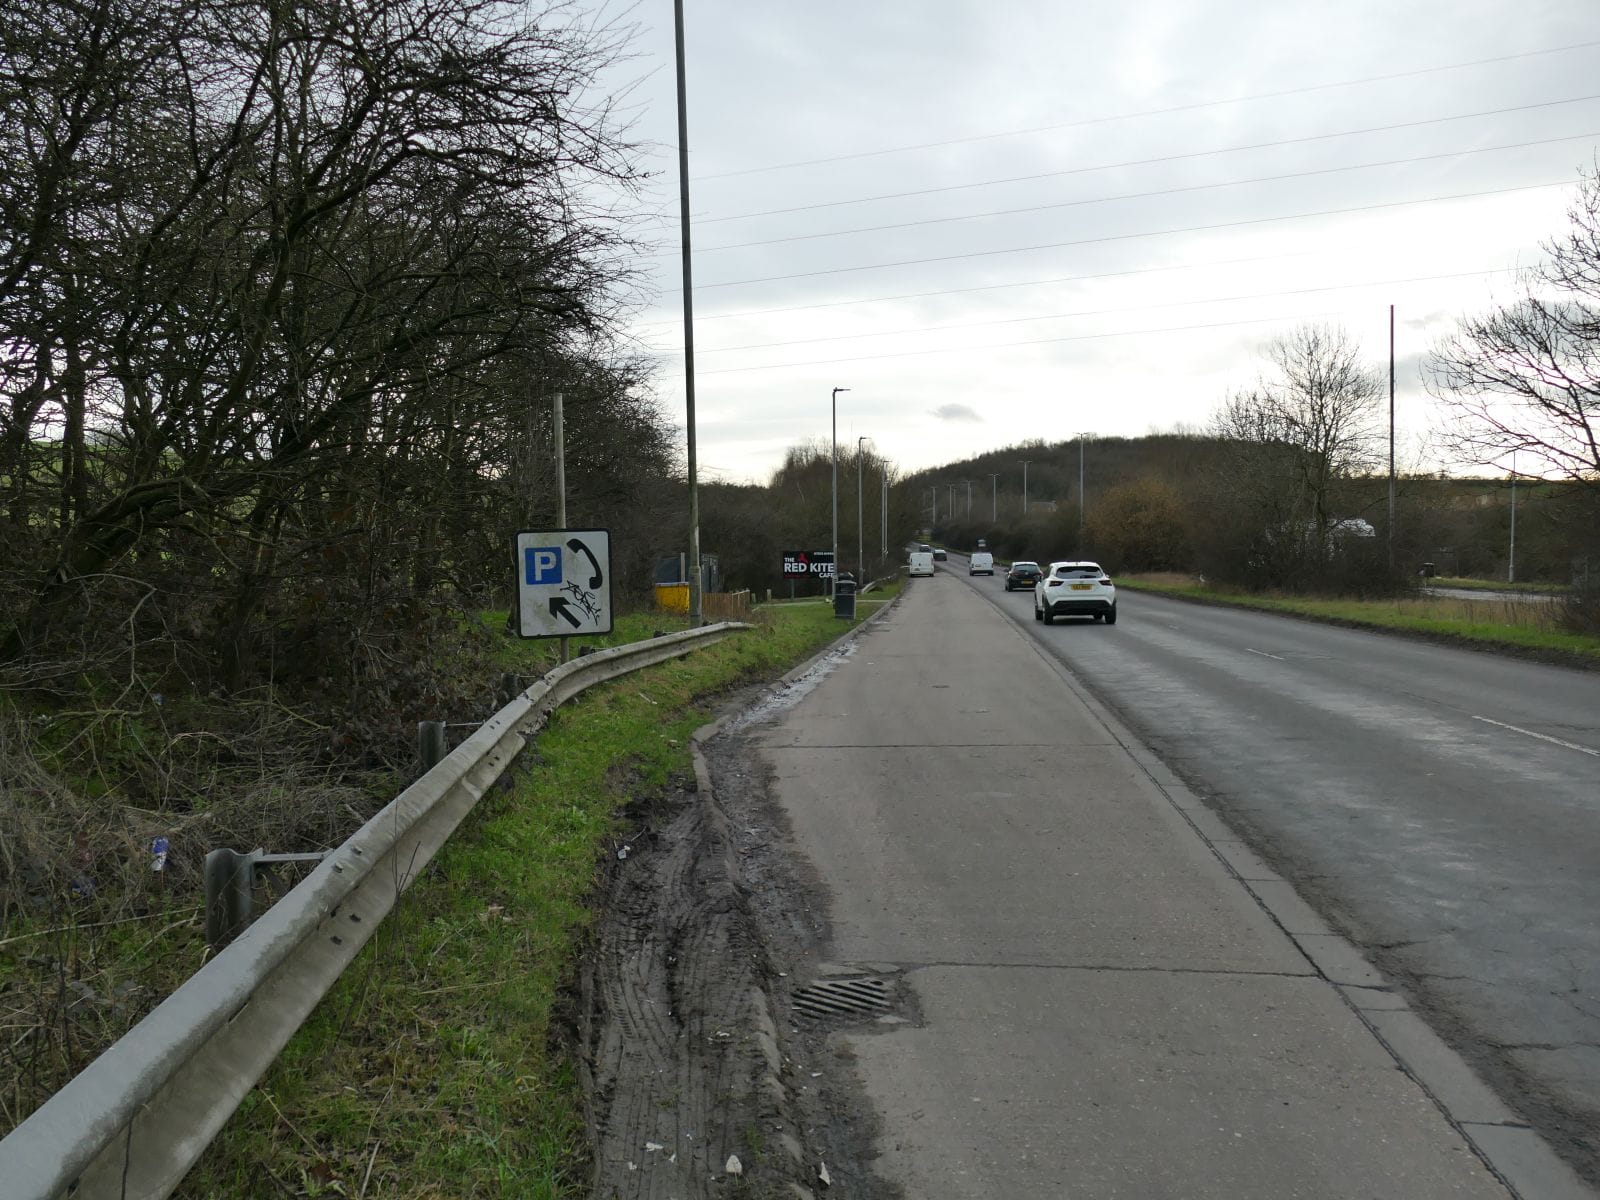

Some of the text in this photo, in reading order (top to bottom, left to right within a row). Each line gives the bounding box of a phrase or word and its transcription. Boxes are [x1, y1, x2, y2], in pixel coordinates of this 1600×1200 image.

[534, 551, 557, 581] P
[784, 563, 834, 572] RED KITE
